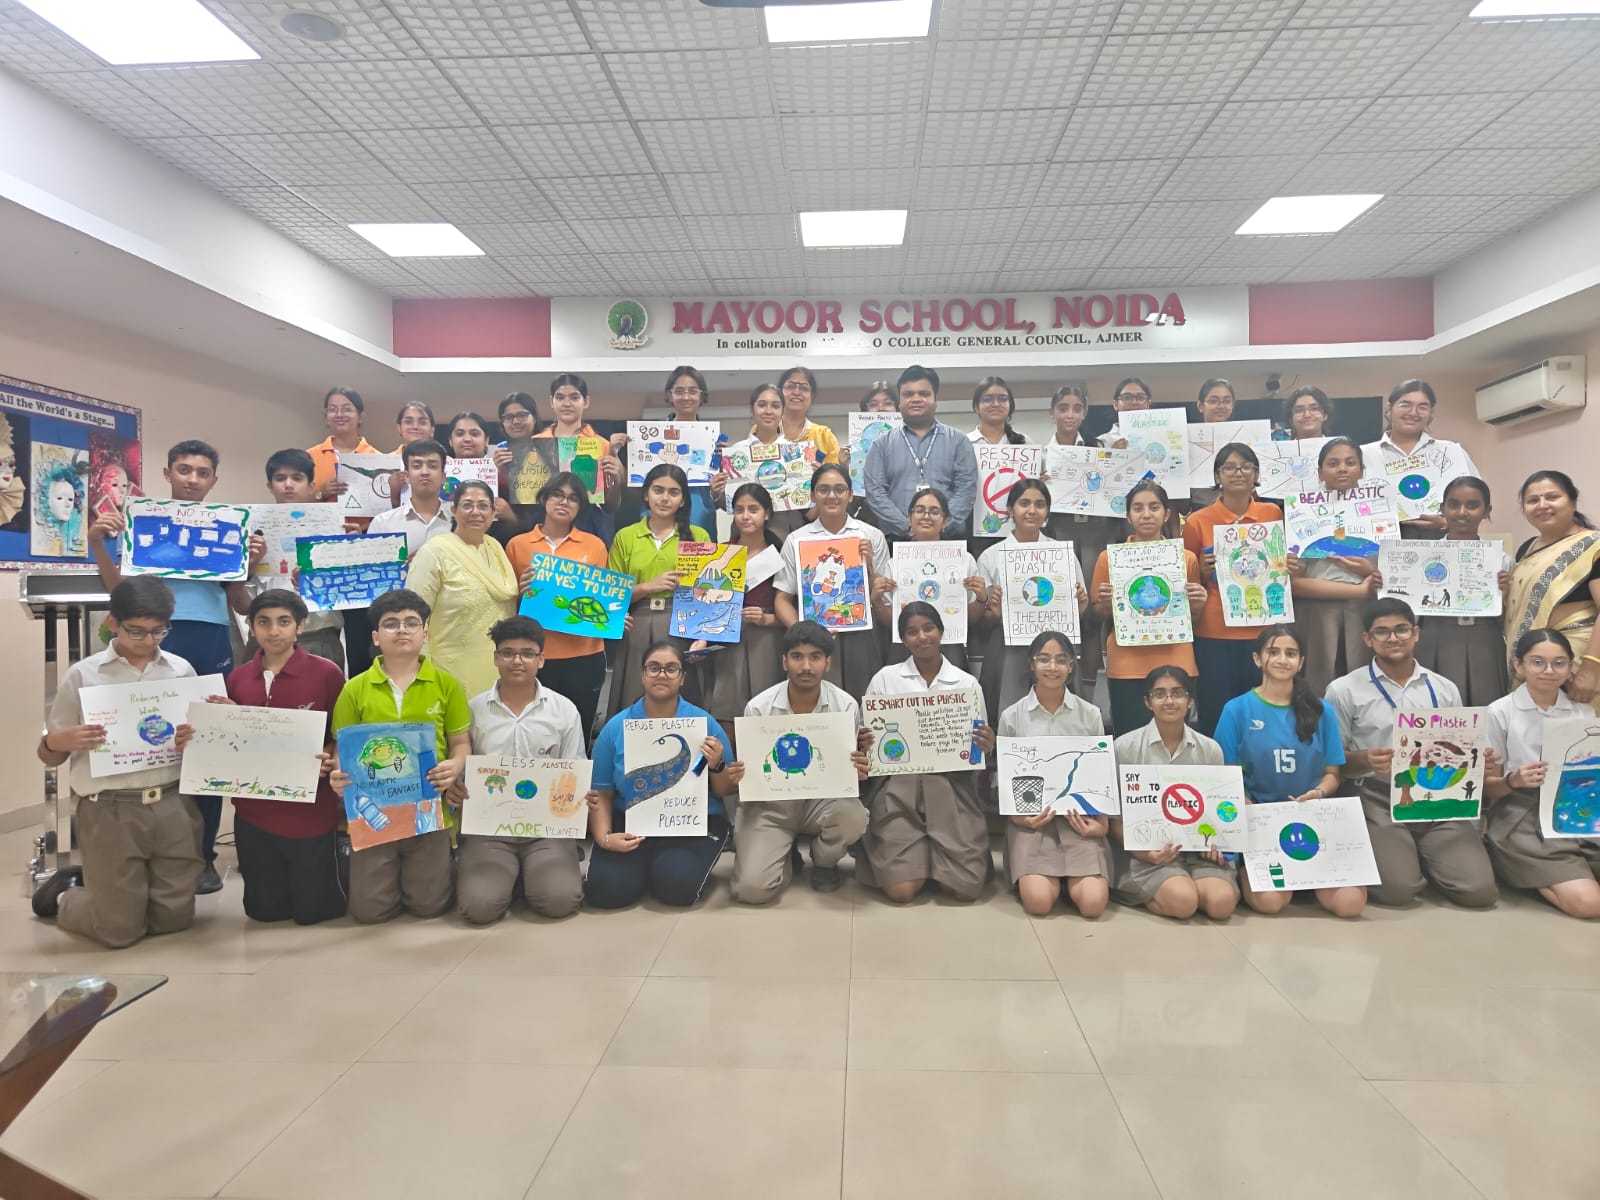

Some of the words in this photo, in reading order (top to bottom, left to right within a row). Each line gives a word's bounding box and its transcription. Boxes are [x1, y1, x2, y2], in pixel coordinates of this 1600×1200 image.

[672, 300, 844, 333] MAYOOR
[860, 297, 1036, 334] SCHOOL,
[1052, 292, 1187, 328] NOIDA
[717, 339, 729, 349] In
[734, 339, 807, 349] collaboration
[888, 336, 951, 348] COLLEGE
[957, 335, 1021, 347] GENERAL
[1025, 333, 1092, 346] COUNCIL,
[1096, 331, 1143, 344] AJMER
[0, 393, 14, 405] All
[16, 398, 33, 409] the
[36, 401, 72, 417] World's
[74, 411, 80, 419] a
[979, 447, 1040, 463] RESIST
[1299, 490, 1333, 505] BEAT
[1337, 485, 1385, 501] PLASTIC
[1007, 550, 1029, 563] SAY
[1031, 550, 1047, 562] NO
[1048, 549, 1063, 561] TO
[531, 553, 559, 571] SAY
[559, 559, 575, 575] NO
[576, 563, 591, 578] TO
[591, 569, 634, 589] PLASTIC
[1014, 561, 1058, 575] PLASTIC
[536, 568, 554, 582] AY
[554, 573, 579, 590] YES
[582, 578, 600, 595] TO
[600, 585, 627, 601] LIFE
[1013, 610, 1037, 623] THE
[1038, 609, 1067, 623] EARTH
[866, 699, 878, 711] BE
[879, 697, 904, 711] SMART
[906, 697, 919, 708] CUT
[921, 695, 935, 707] THE
[937, 692, 967, 705] PLASTIC
[661, 718, 696, 730] PLASTIC
[1430, 714, 1467, 729] Plastic
[500, 757, 536, 769] LESS
[541, 762, 575, 770] PLASTIC
[1273, 749, 1296, 774] 15
[1125, 773, 1140, 782] SAY
[388, 783, 420, 798] FANTAST
[1127, 783, 1140, 791] NO
[1149, 782, 1160, 791] TO
[664, 796, 697, 808] REDUCE
[1126, 795, 1158, 804] PLASTIC
[659, 813, 700, 828] PLASTIC
[495, 822, 543, 837] MORE
[545, 825, 581, 837] PLANET
